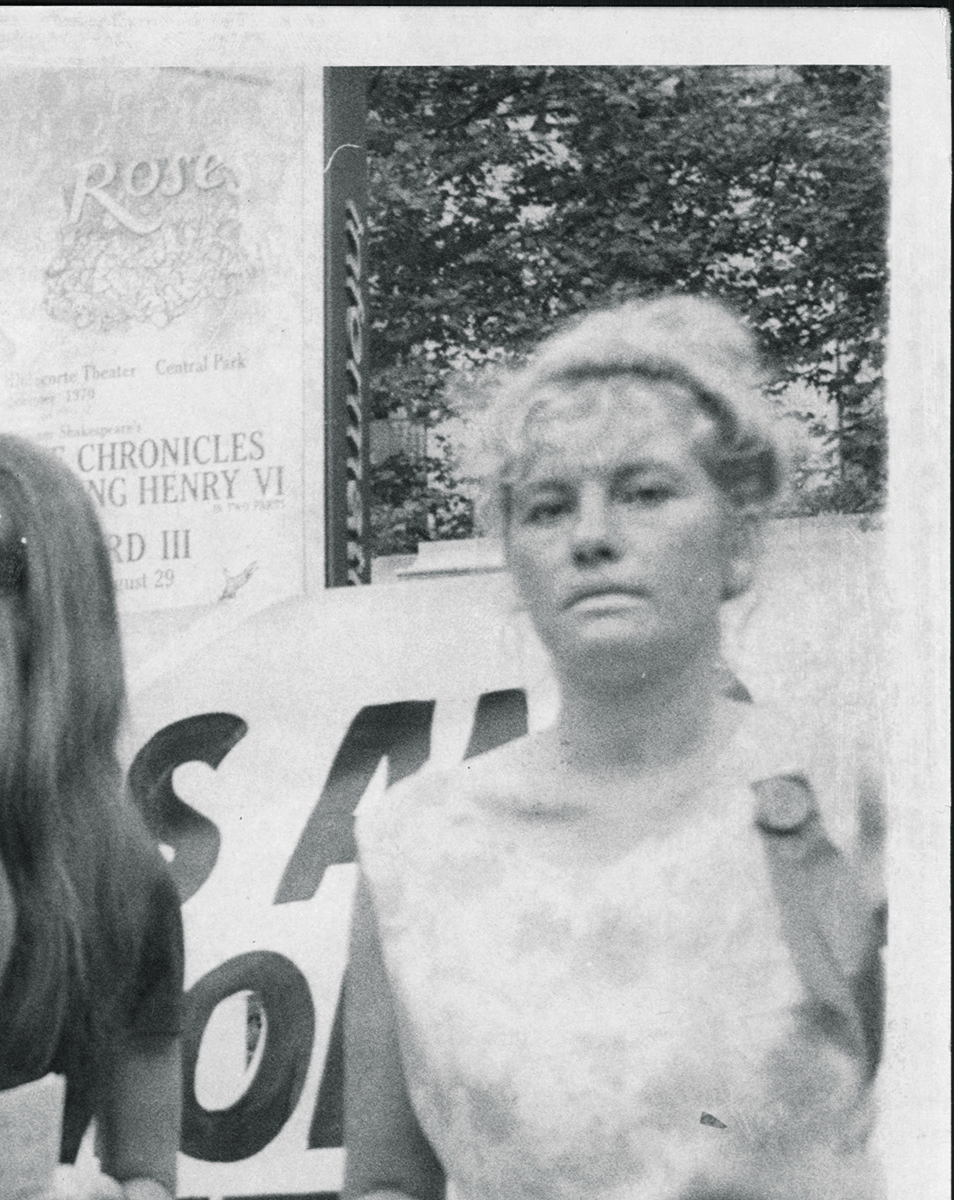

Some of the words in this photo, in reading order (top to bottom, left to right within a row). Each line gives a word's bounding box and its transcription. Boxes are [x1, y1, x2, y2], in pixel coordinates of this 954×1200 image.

[68, 150, 252, 235] Roses
[82, 364, 137, 382] Theater
[155, 356, 208, 375] Central
[213, 352, 247, 371] Park
[77, 430, 266, 473] CHRONICLES
[88, 476, 128, 508] NG
[138, 468, 241, 506] HENRY
[253, 465, 286, 497] VI
[160, 528, 192, 561] III
[153, 568, 176, 589] 29
